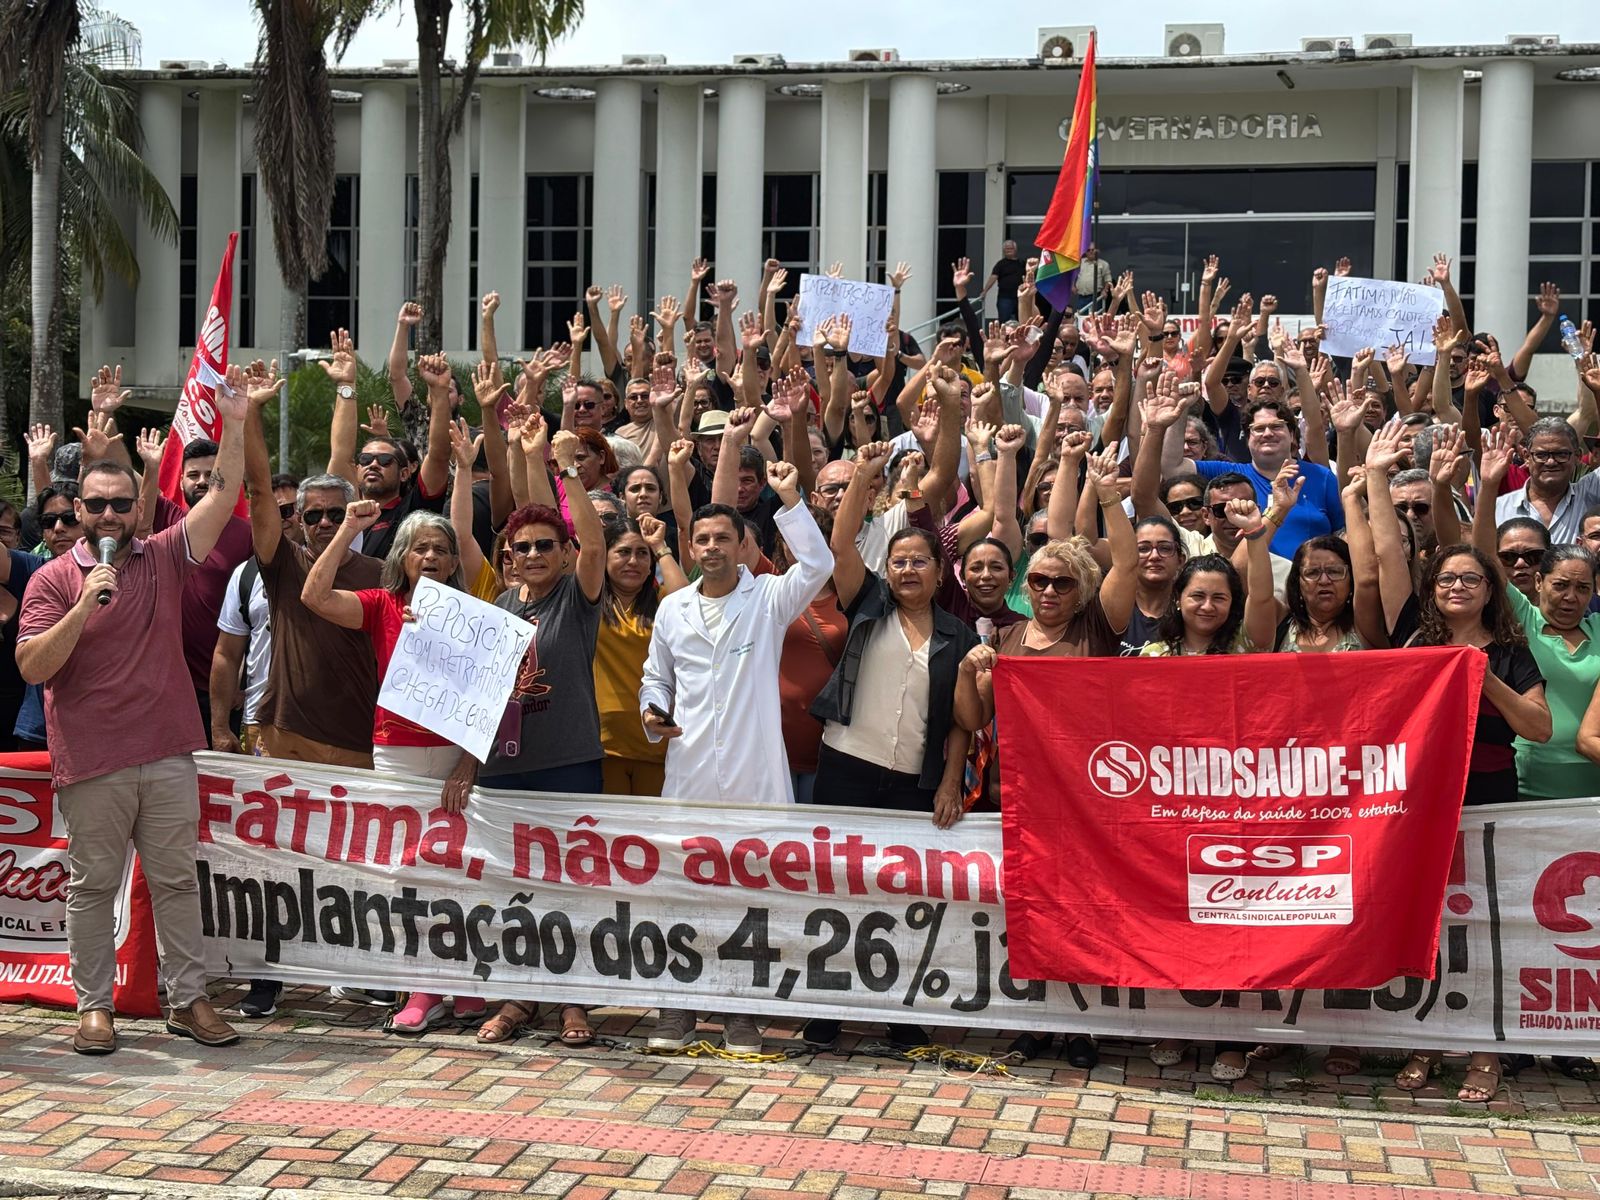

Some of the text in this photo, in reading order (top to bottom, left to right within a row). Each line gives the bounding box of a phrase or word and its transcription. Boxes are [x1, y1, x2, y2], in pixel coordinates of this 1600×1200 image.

[390, 667, 448, 715] CHEGA
[1150, 737, 1407, 798] SINDSAÚDE-RN
[1151, 800, 1408, 822] Em defesa da saúde 100% estatal
[197, 773, 1005, 905] Fátima, não aceitam
[1200, 845, 1342, 868] CSP
[1206, 877, 1338, 903] Conlutas
[196, 860, 577, 981] Implantação
[590, 900, 703, 983] dos
[717, 901, 950, 1007] 4,26%
[1519, 967, 1600, 1012] SIN
[1519, 1013, 1562, 1030] FILIADO
